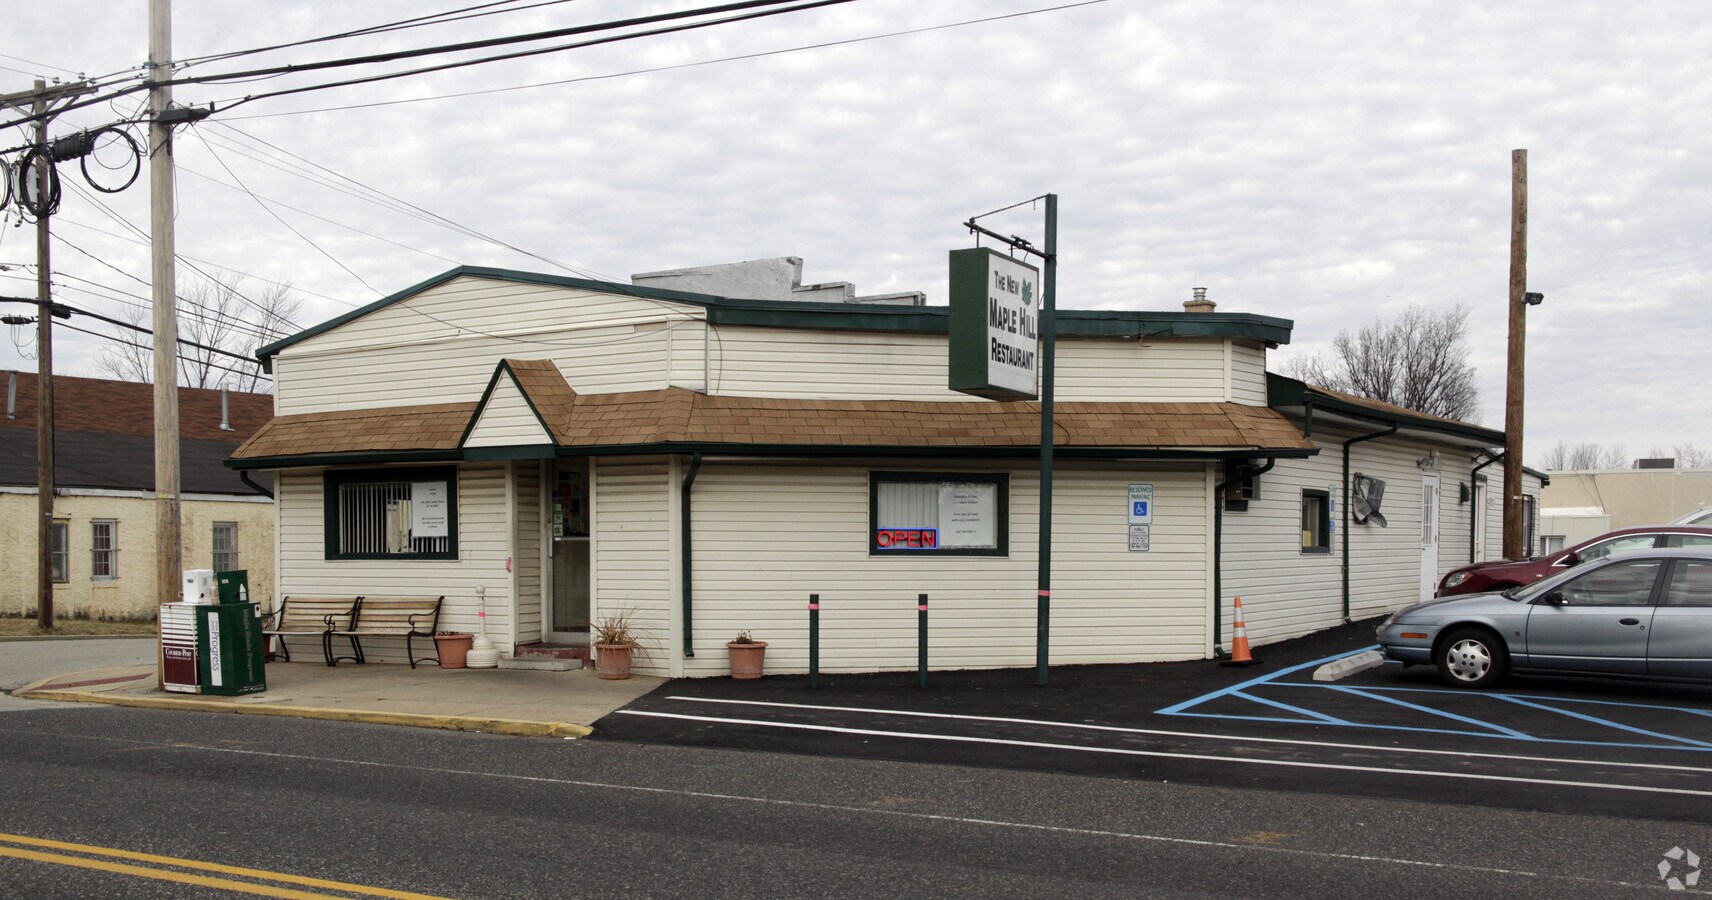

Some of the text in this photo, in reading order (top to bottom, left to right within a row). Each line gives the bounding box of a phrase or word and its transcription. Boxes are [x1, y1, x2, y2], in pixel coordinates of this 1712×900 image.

[990, 297, 1036, 340] MAPLE HILL
[991, 336, 1034, 371] RESTAURANT
[877, 530, 935, 547] OPEN
[210, 631, 220, 672] Progress
